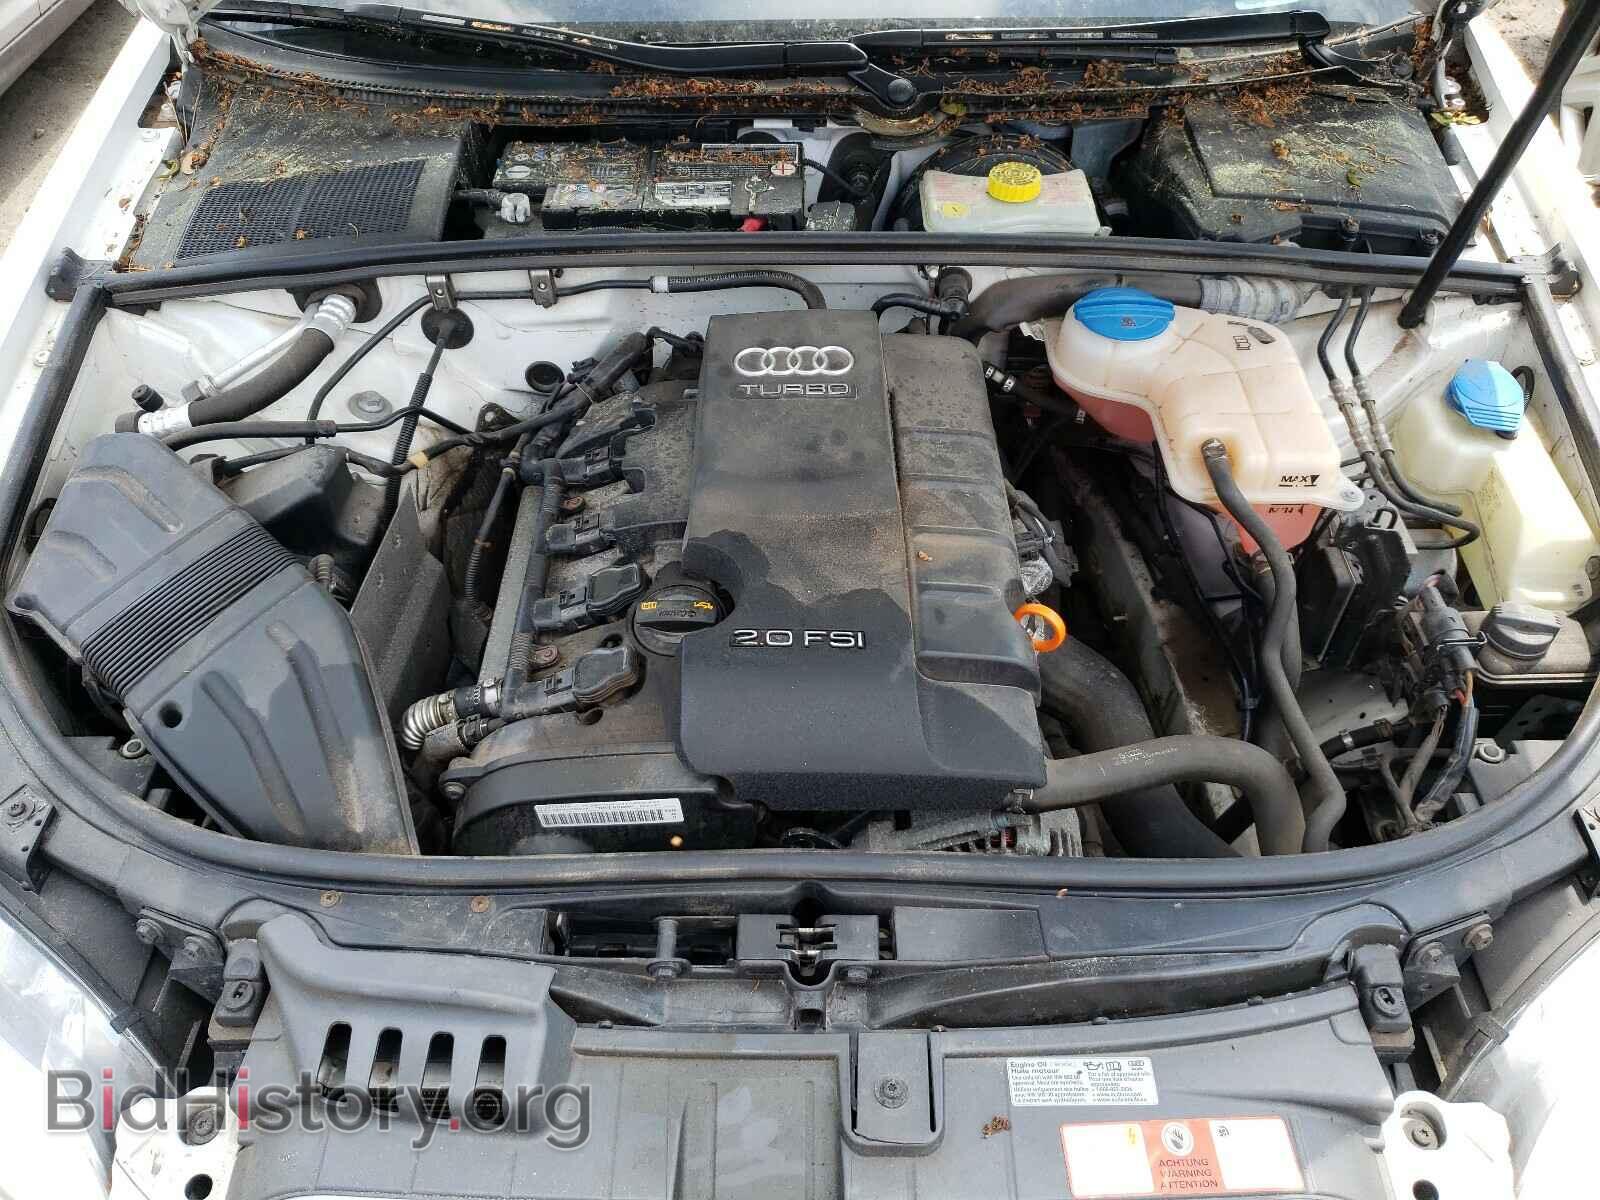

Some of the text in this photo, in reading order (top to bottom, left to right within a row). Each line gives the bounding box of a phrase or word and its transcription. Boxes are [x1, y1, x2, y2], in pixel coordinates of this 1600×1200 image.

[739, 383, 849, 396] TURBO
[1281, 475, 1309, 483] MAX
[733, 629, 864, 647] 2.0 FSI
[1010, 1061, 1034, 1069] Engine
[1159, 1158, 1209, 1168] ACHTUNG
[1160, 1168, 1212, 1178] WARNING
[1160, 1179, 1218, 1190] ATTENTION
